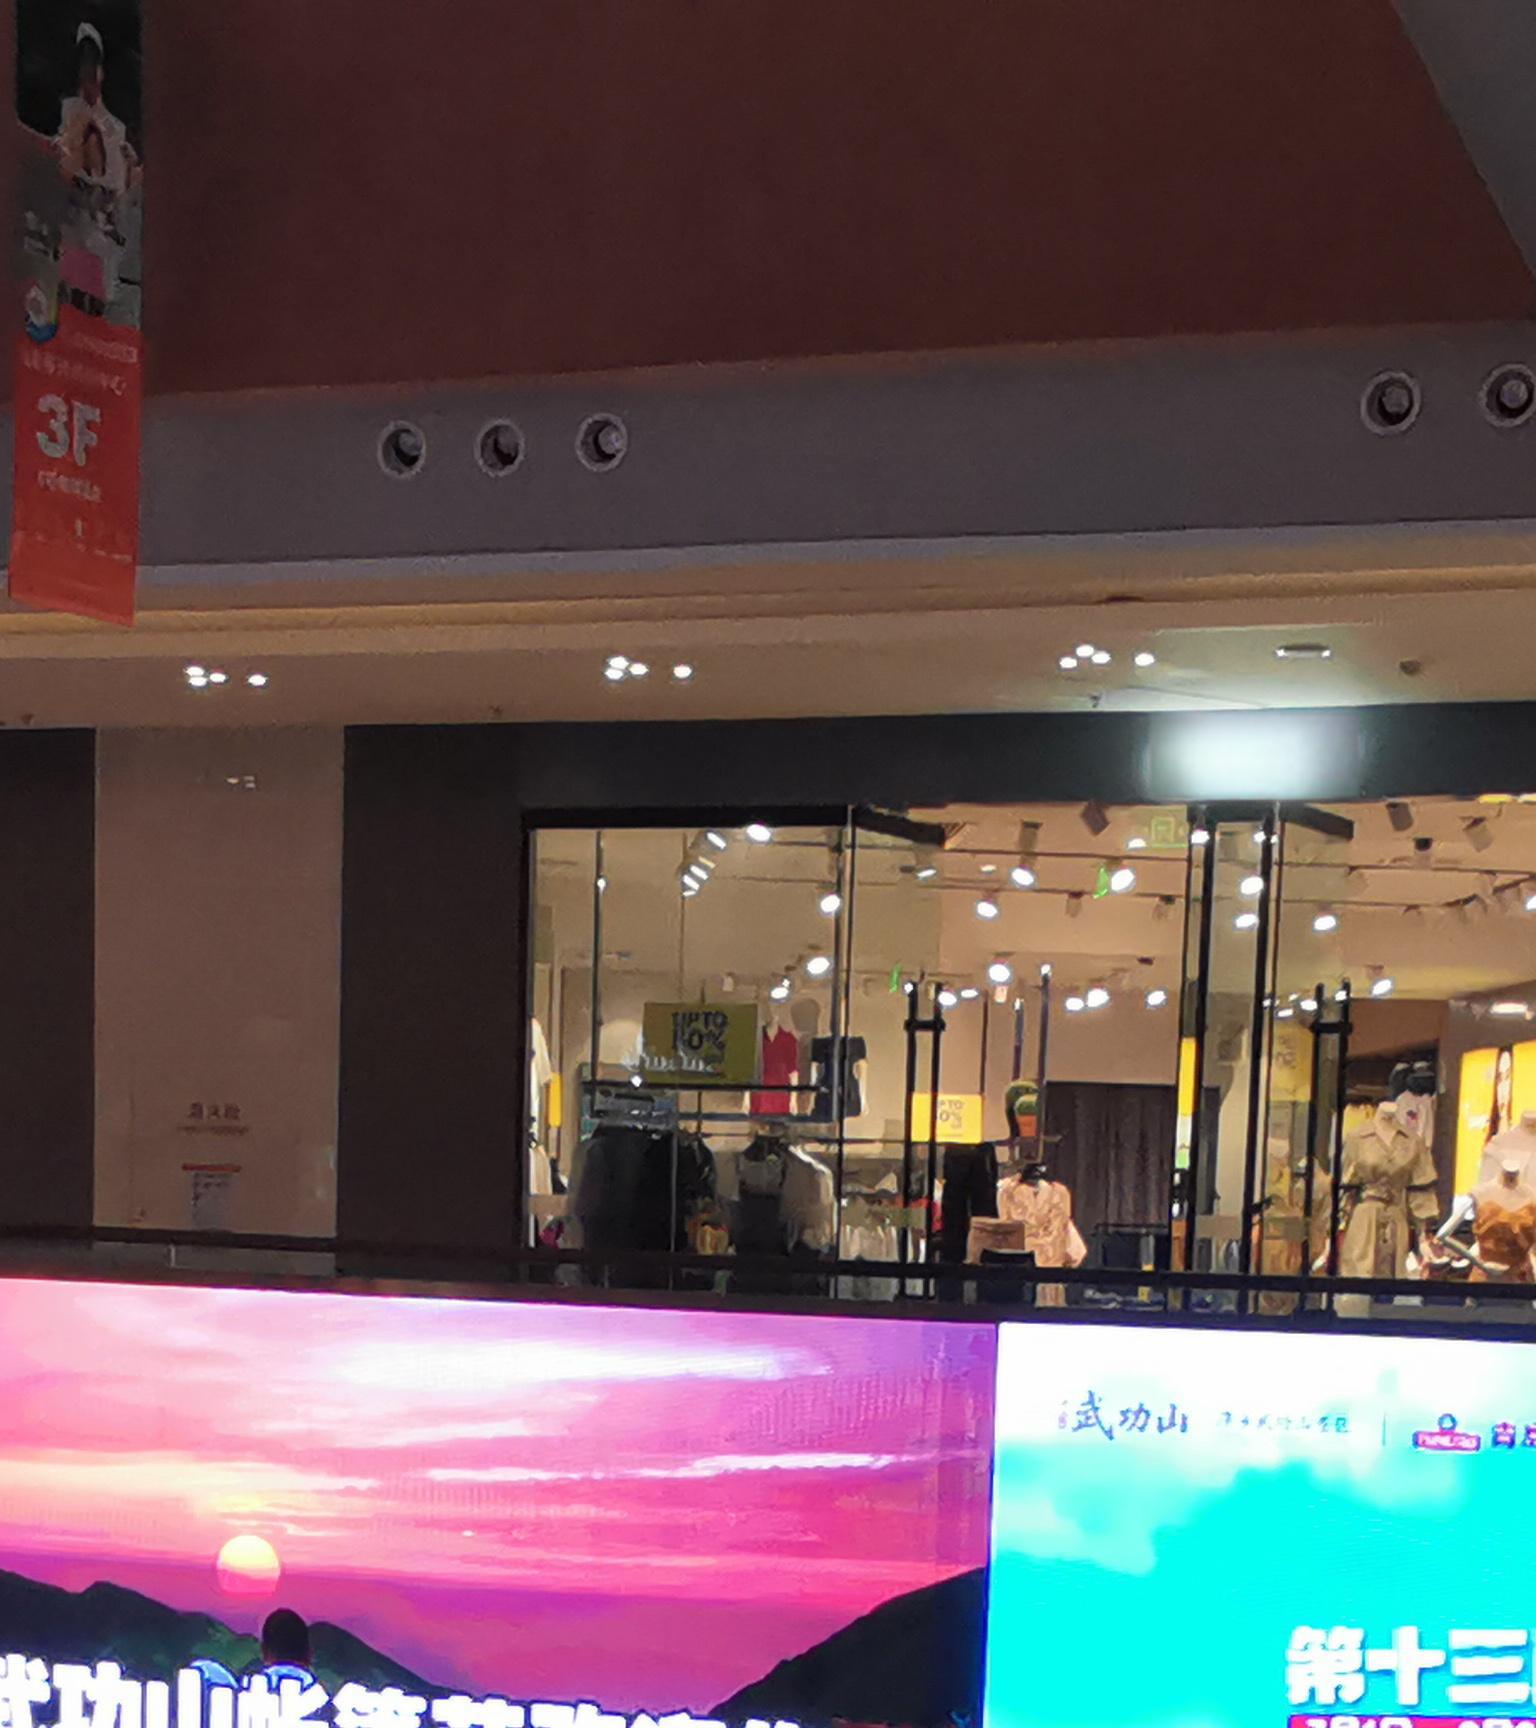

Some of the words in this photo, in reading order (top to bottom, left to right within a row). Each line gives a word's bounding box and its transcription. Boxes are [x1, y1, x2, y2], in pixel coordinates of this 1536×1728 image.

[37, 394, 102, 467] 3F
[1072, 1390, 1188, 1441] 武功山
